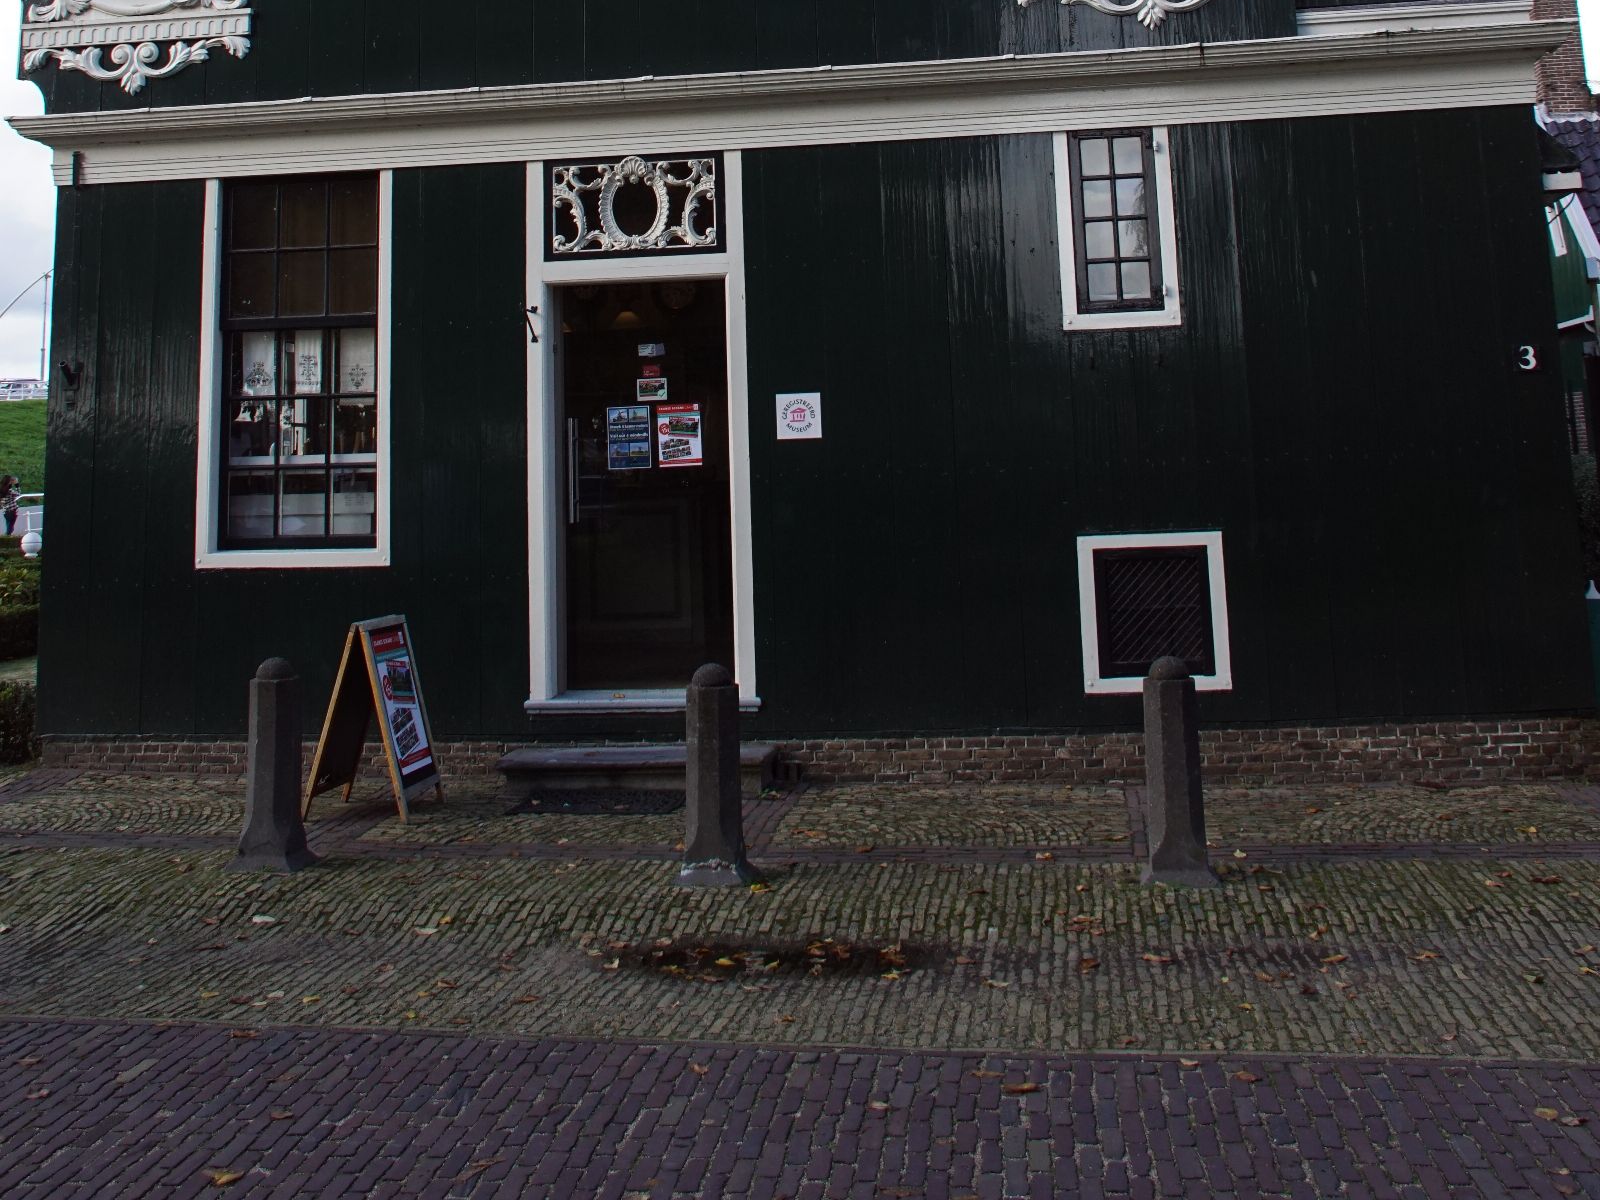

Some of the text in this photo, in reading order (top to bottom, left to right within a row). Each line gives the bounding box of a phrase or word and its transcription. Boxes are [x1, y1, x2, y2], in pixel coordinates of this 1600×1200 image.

[1518, 345, 1537, 370] 3
[782, 399, 816, 419] GEREGISTREERD
[786, 422, 812, 432] MUSEUM
